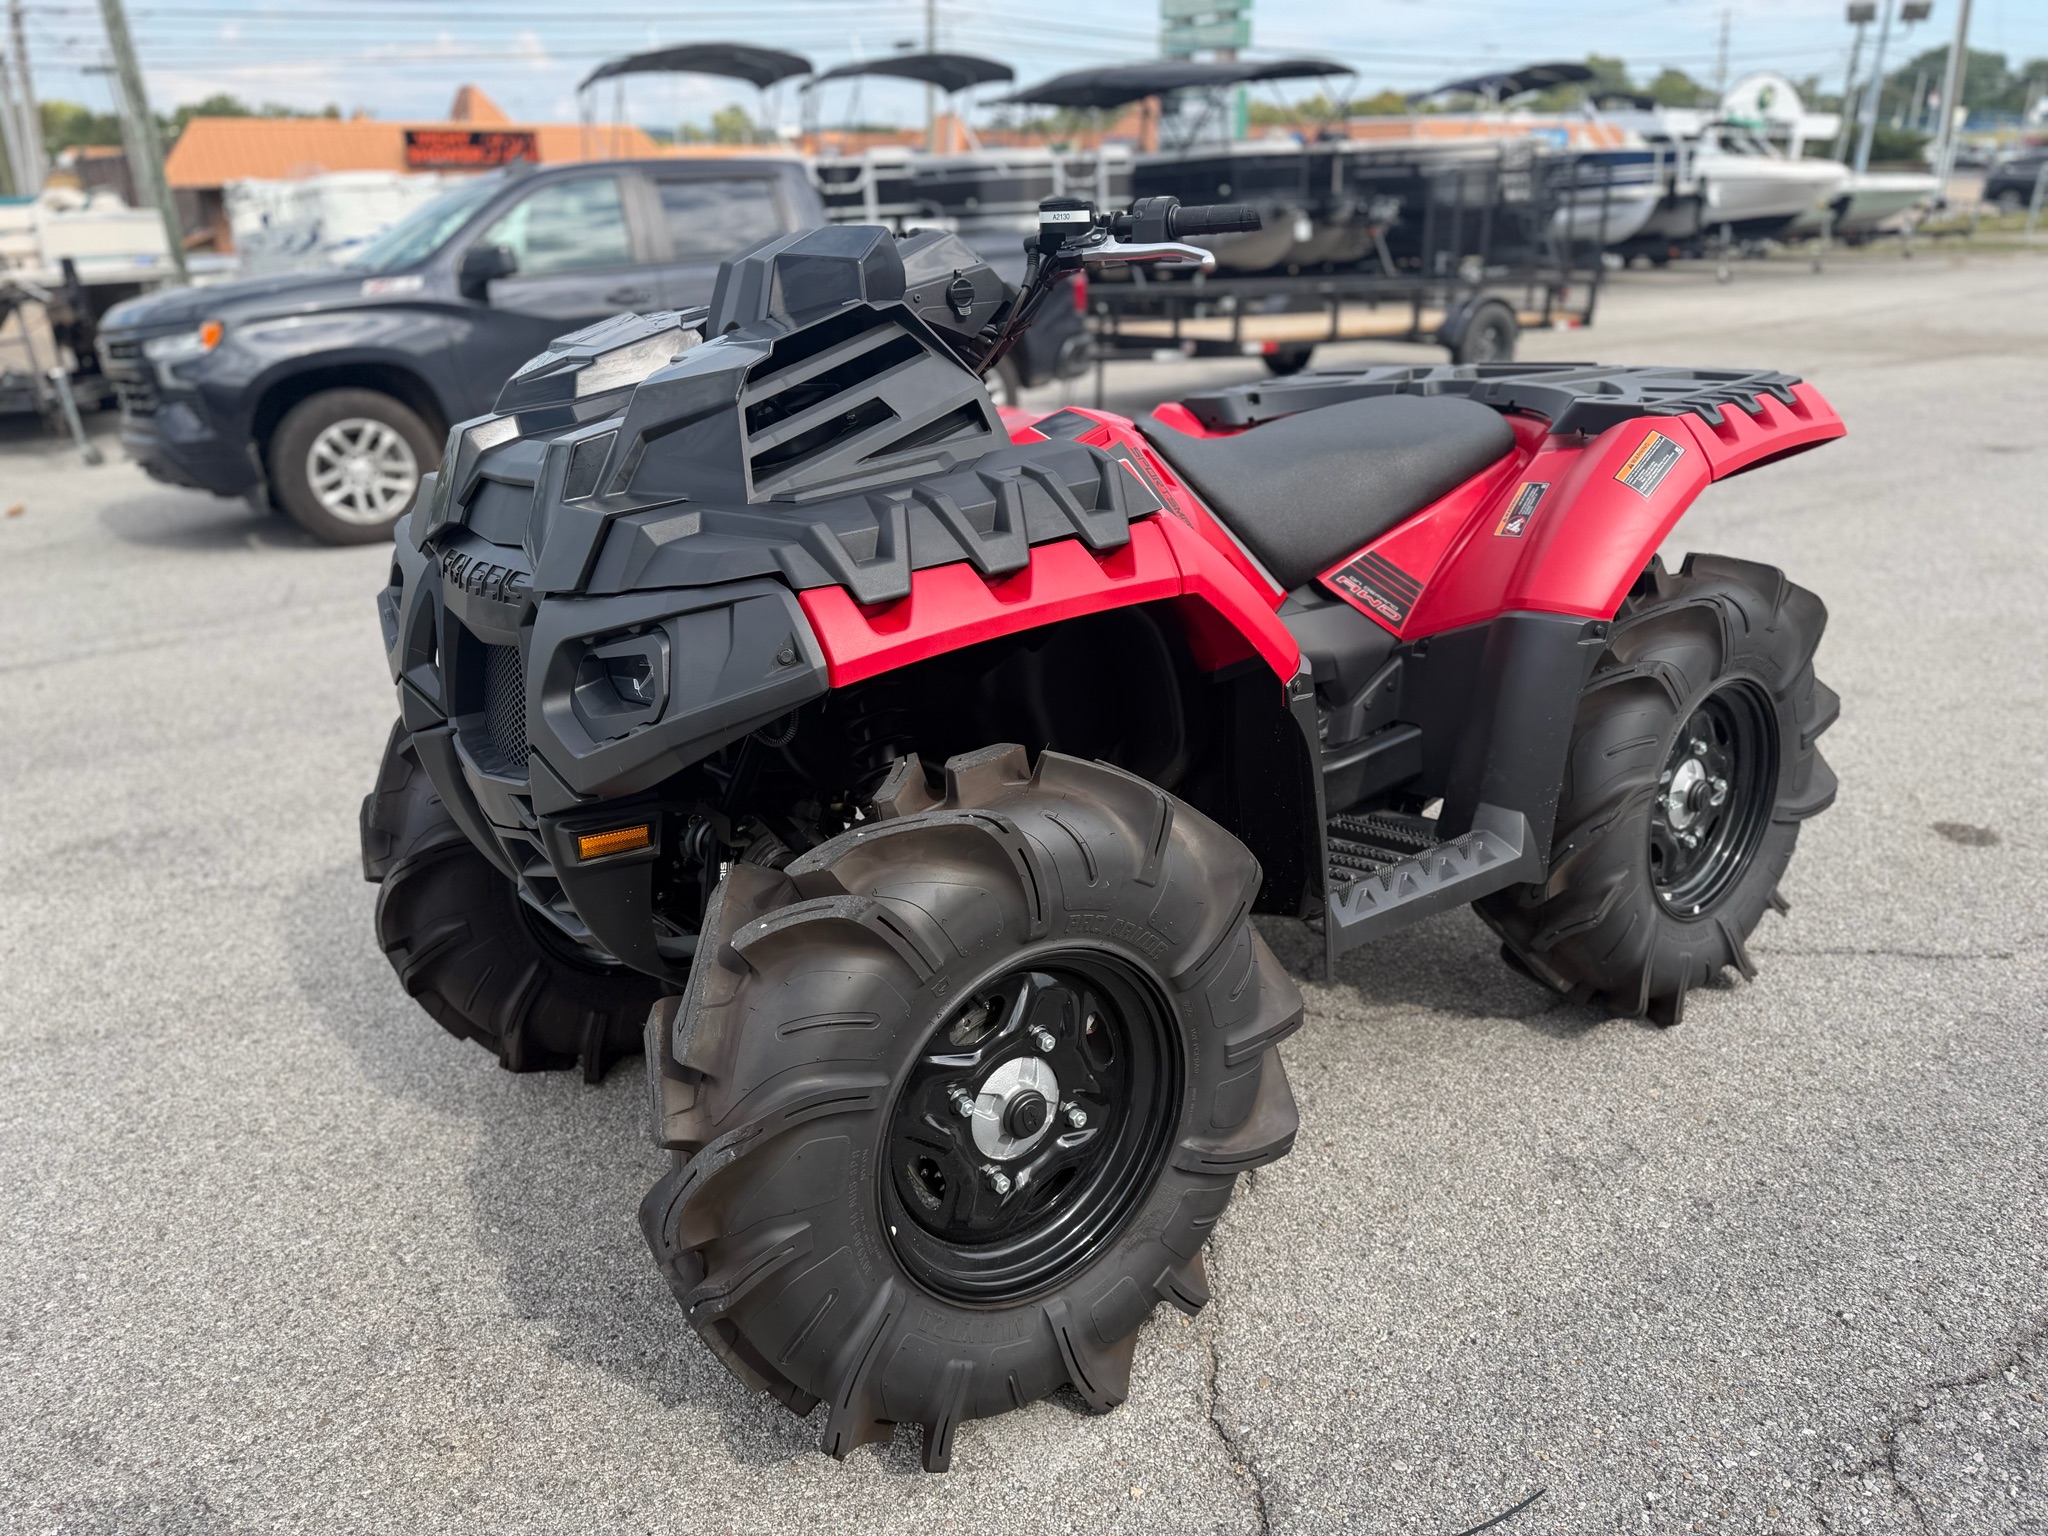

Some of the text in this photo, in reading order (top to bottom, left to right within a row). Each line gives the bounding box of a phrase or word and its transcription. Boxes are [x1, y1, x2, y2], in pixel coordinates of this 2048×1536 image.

[1052, 213, 1070, 221] A2130
[1631, 442, 1650, 465] WARNING
[443, 549, 530, 605] POLARIS
[1336, 575, 1402, 621] AWD
[1106, 918, 1169, 962] ARMOR
